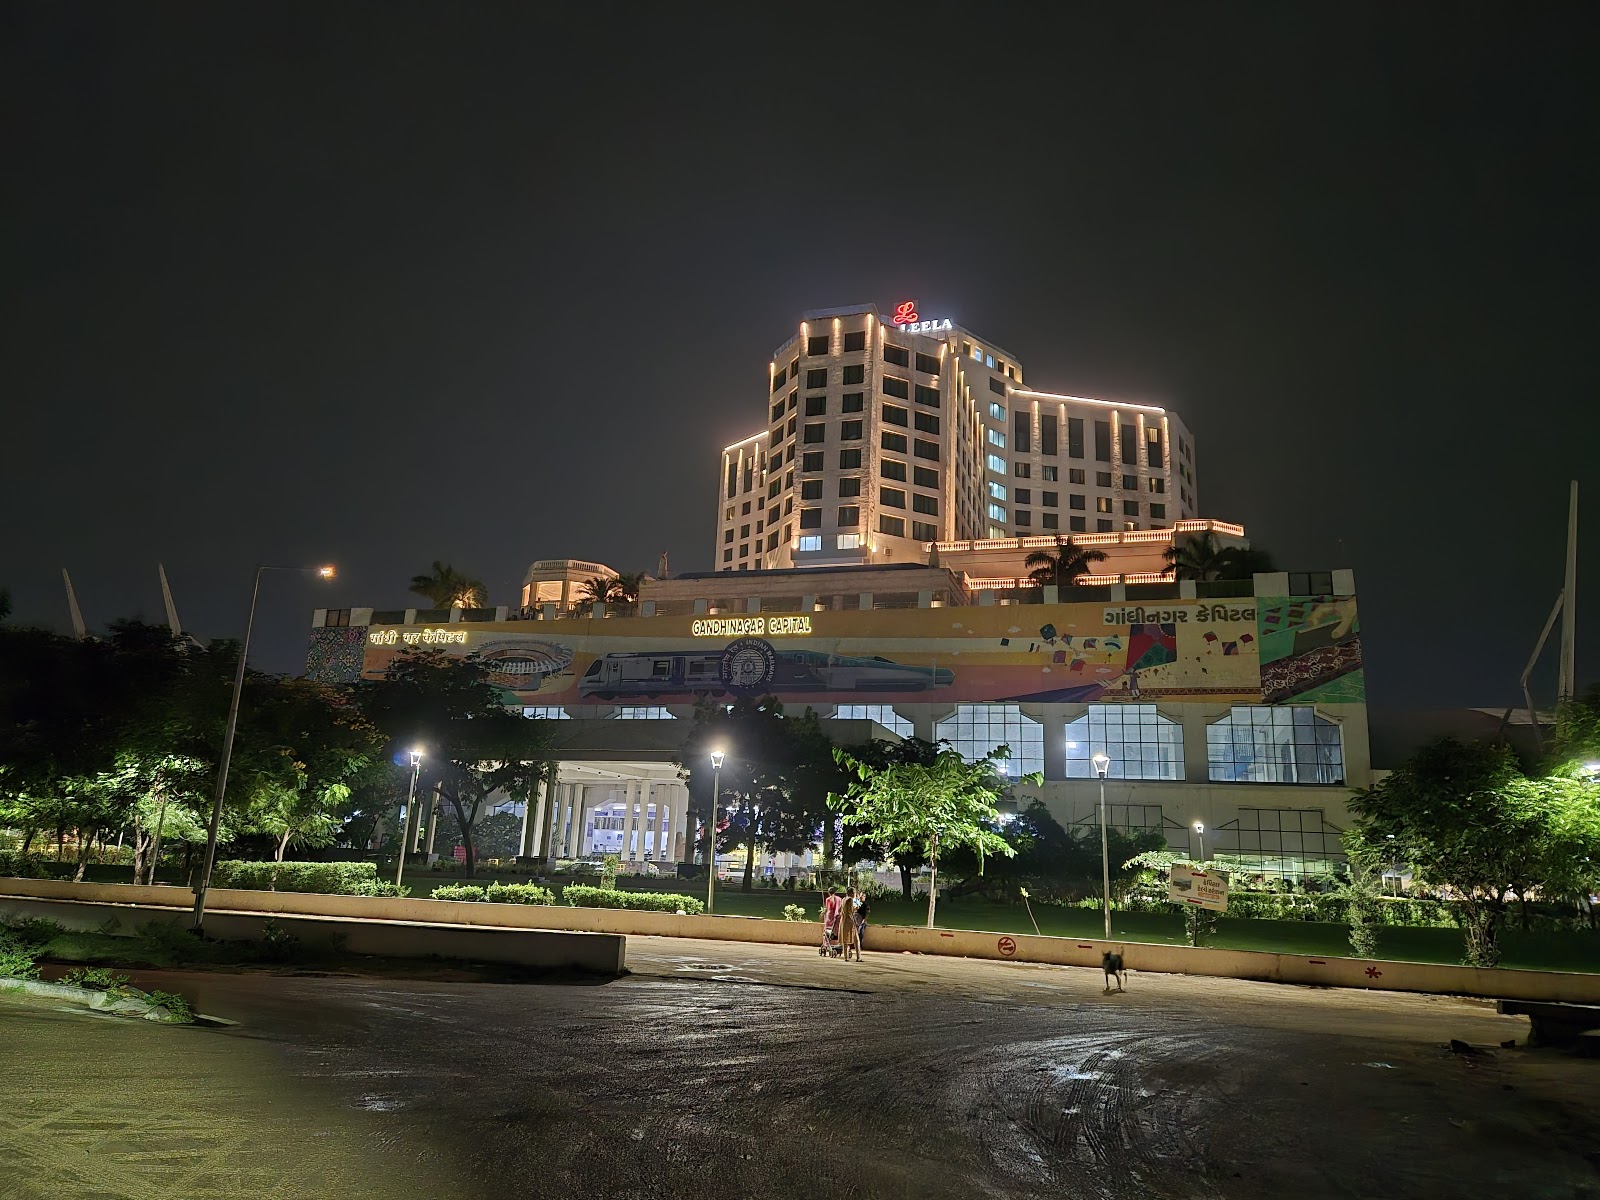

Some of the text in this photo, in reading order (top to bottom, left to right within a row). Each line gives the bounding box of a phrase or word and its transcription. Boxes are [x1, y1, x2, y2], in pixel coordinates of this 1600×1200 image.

[900, 319, 953, 333] LEELA
[1105, 605, 1256, 625] ગાંધીનગર કેપિટલ
[692, 617, 812, 637] GANDHINAGAR CAPITAL
[746, 639, 768, 652] INDIAN
